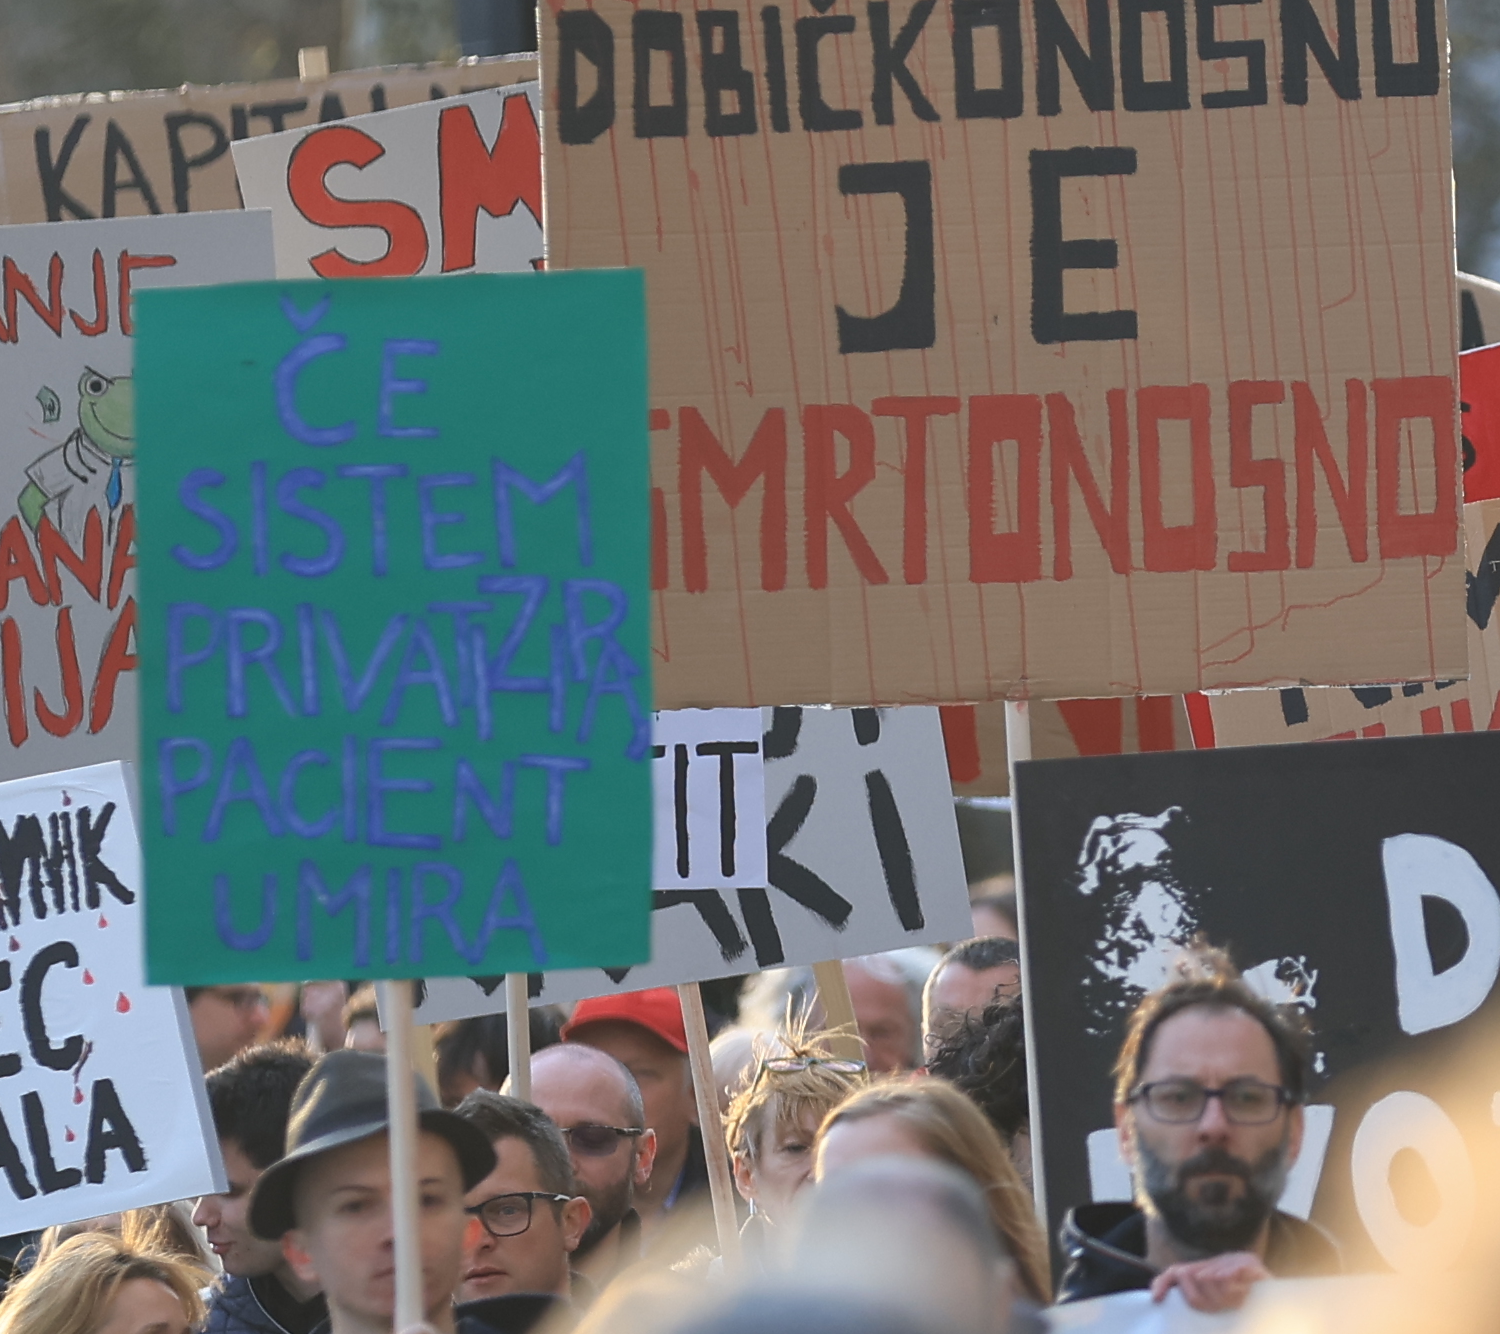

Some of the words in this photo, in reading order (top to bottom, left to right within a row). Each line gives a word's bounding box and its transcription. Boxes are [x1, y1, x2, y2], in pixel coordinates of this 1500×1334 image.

[835, 146, 1139, 355] JE
[273, 291, 442, 447] ČE
[170, 449, 595, 579] SISTEM
[158, 735, 593, 850] PACIENT
[212, 857, 550, 968] UMIRA
